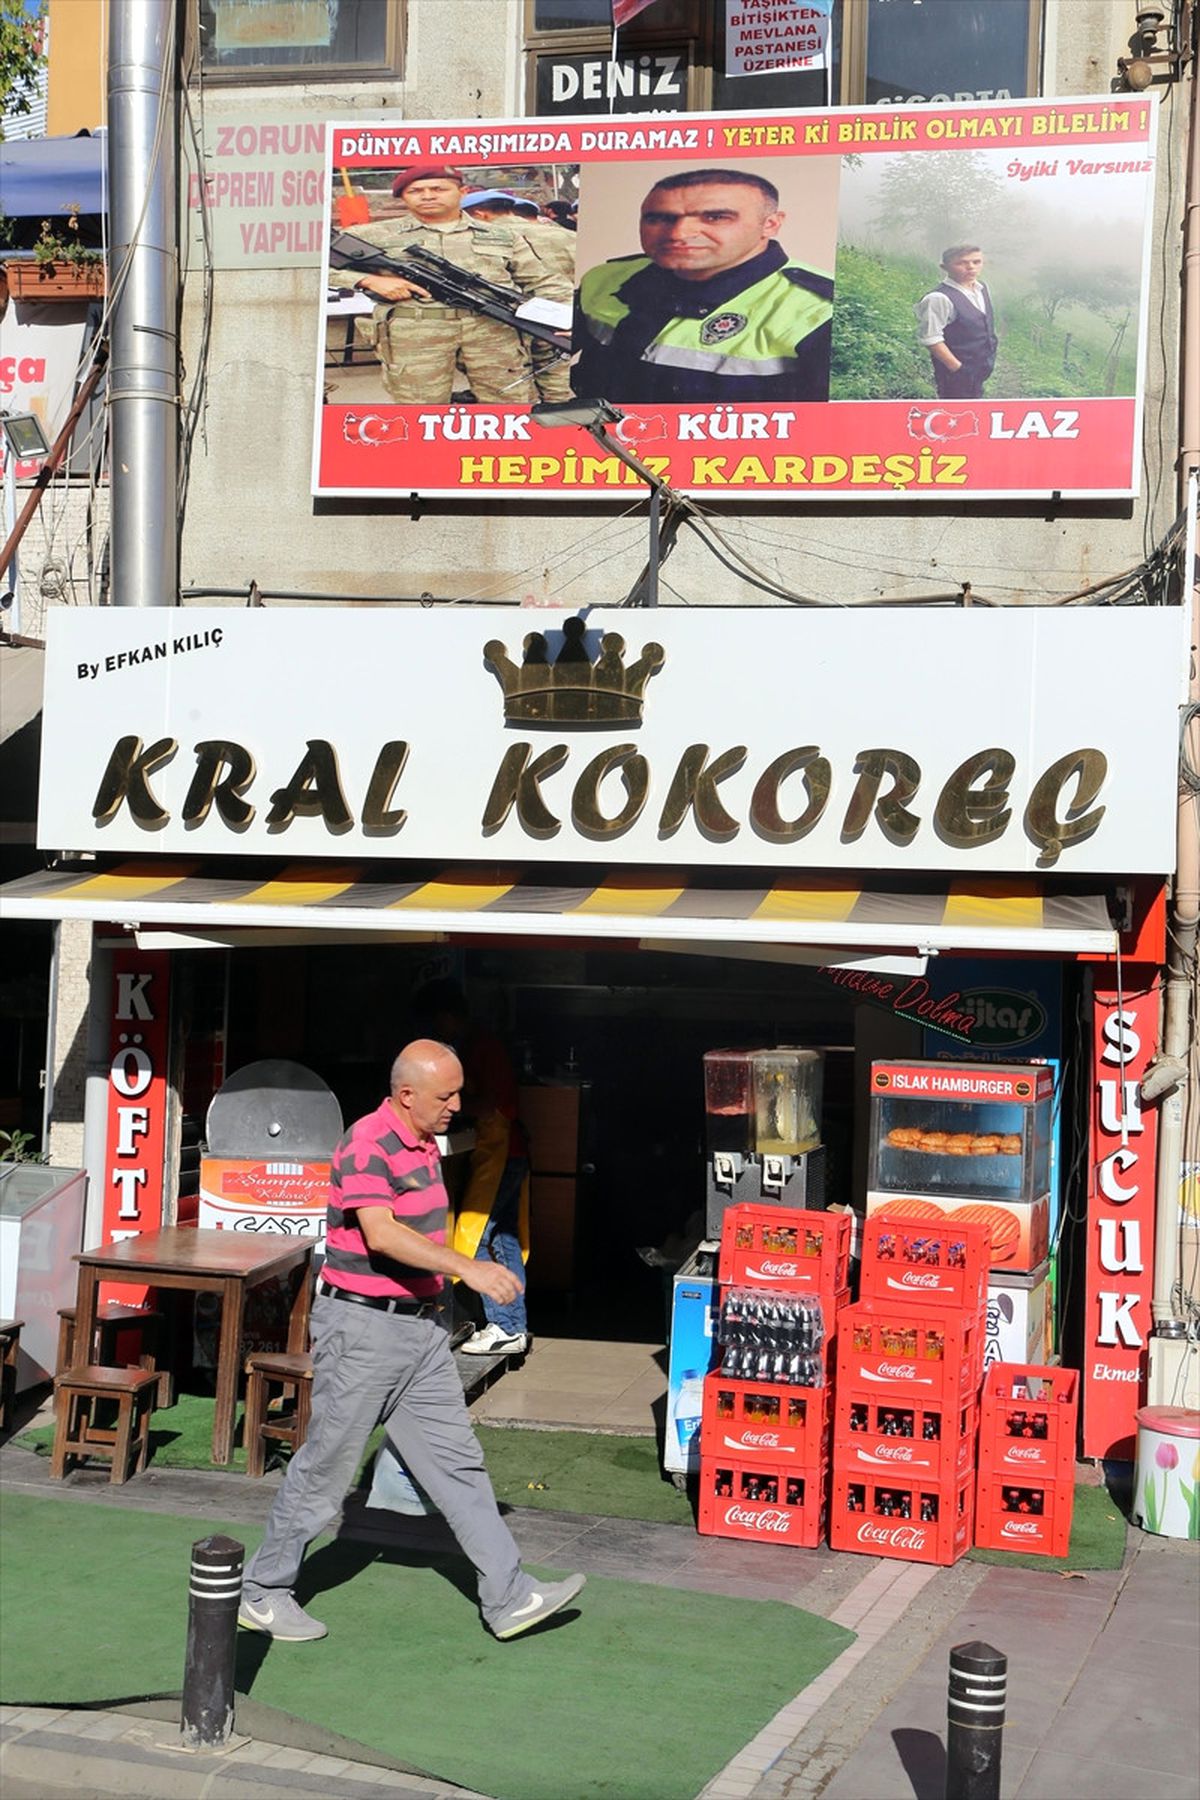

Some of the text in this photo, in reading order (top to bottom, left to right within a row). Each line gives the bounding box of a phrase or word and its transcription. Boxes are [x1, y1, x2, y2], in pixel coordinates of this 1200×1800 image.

[735, 36, 822, 57] PASTANESİ
[740, 24, 817, 41] MEVLANA
[743, 56, 813, 72] ÜZERİNE
[341, 107, 1147, 159] DÜNYA KARŞIMIZDA DURAMAZ ! YETER Kİ BİRLİK OLMAYI BİLELİM !
[1007, 158, 1152, 181] İyiki Varsınız
[240, 220, 323, 254] YAPILI
[418, 405, 1080, 441] TÜRK KÜRT LAZ
[458, 446, 969, 490] HEPİMİZ KARDEŞİZ
[77, 628, 223, 679] By EFKAN KILIÇ
[92, 735, 411, 838] KRAL
[893, 977, 977, 1034] Dolma
[893, 1074, 929, 1090] ISLAK
[932, 1077, 1013, 1095] HAMBURGER
[1093, 1363, 1144, 1383] Ekmek
[741, 1430, 779, 1447] Coca-Cola
[875, 1444, 913, 1461] Coca-Cola
[724, 1505, 792, 1533] Coca-Cola
[857, 1521, 927, 1550] Coca-Cola
